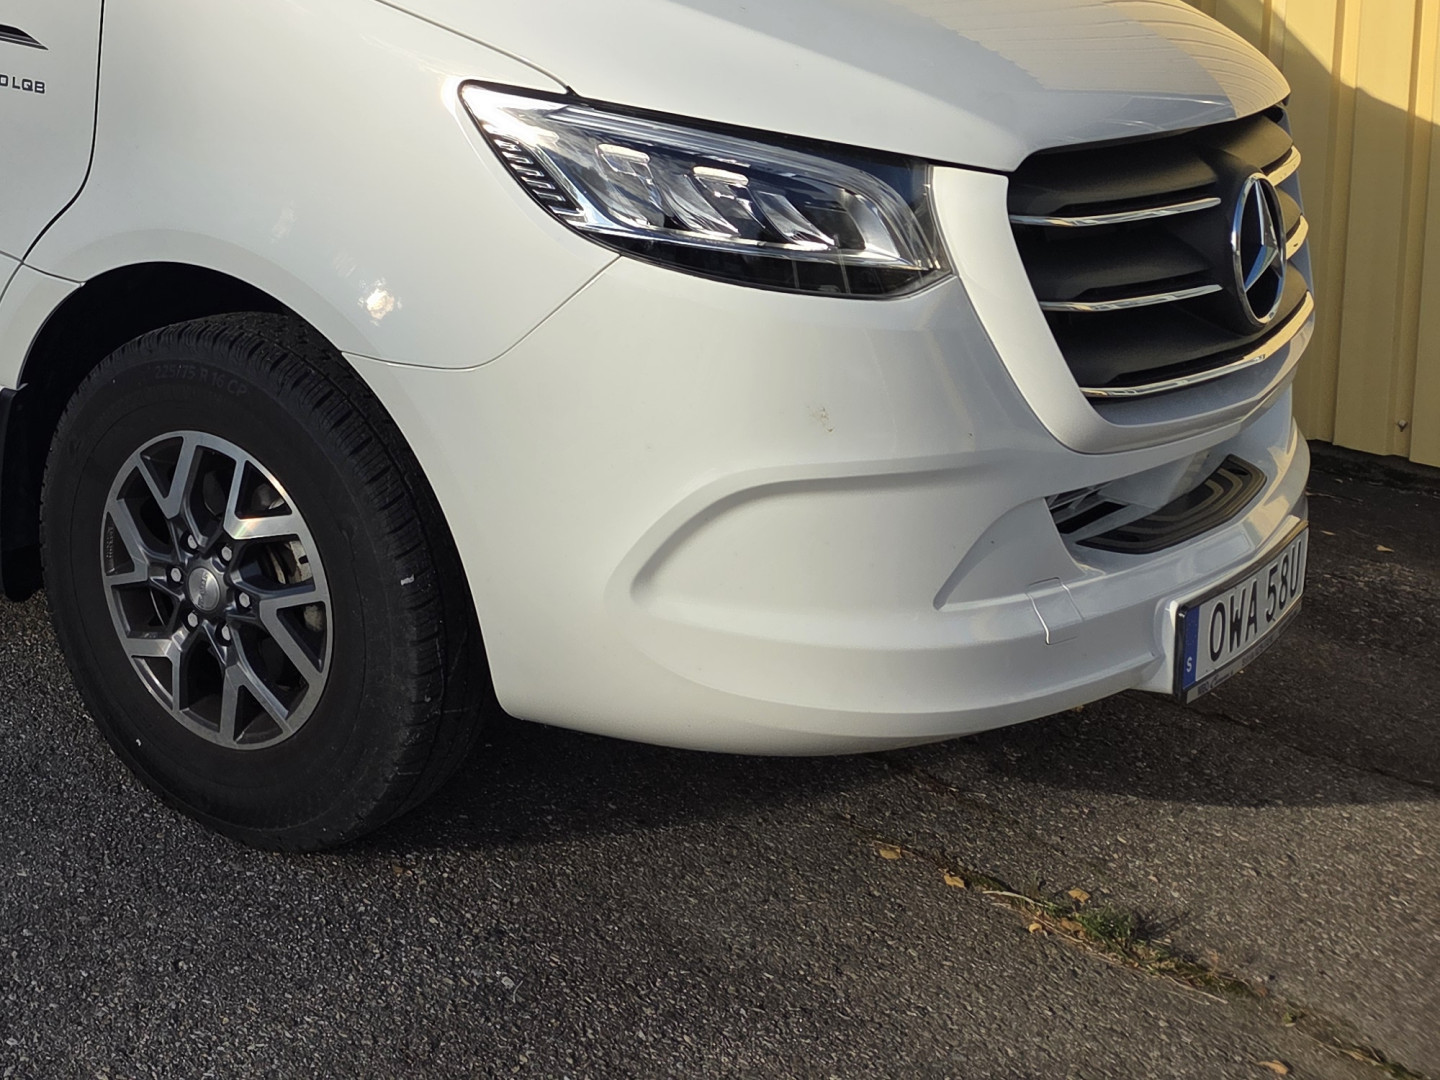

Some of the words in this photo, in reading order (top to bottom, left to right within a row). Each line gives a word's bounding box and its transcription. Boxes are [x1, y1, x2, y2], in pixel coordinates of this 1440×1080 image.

[12, 76, 45, 94] LQB
[1210, 580, 1258, 662] OWA
[1265, 539, 1302, 623] 58U
[1186, 656, 1192, 672] S
